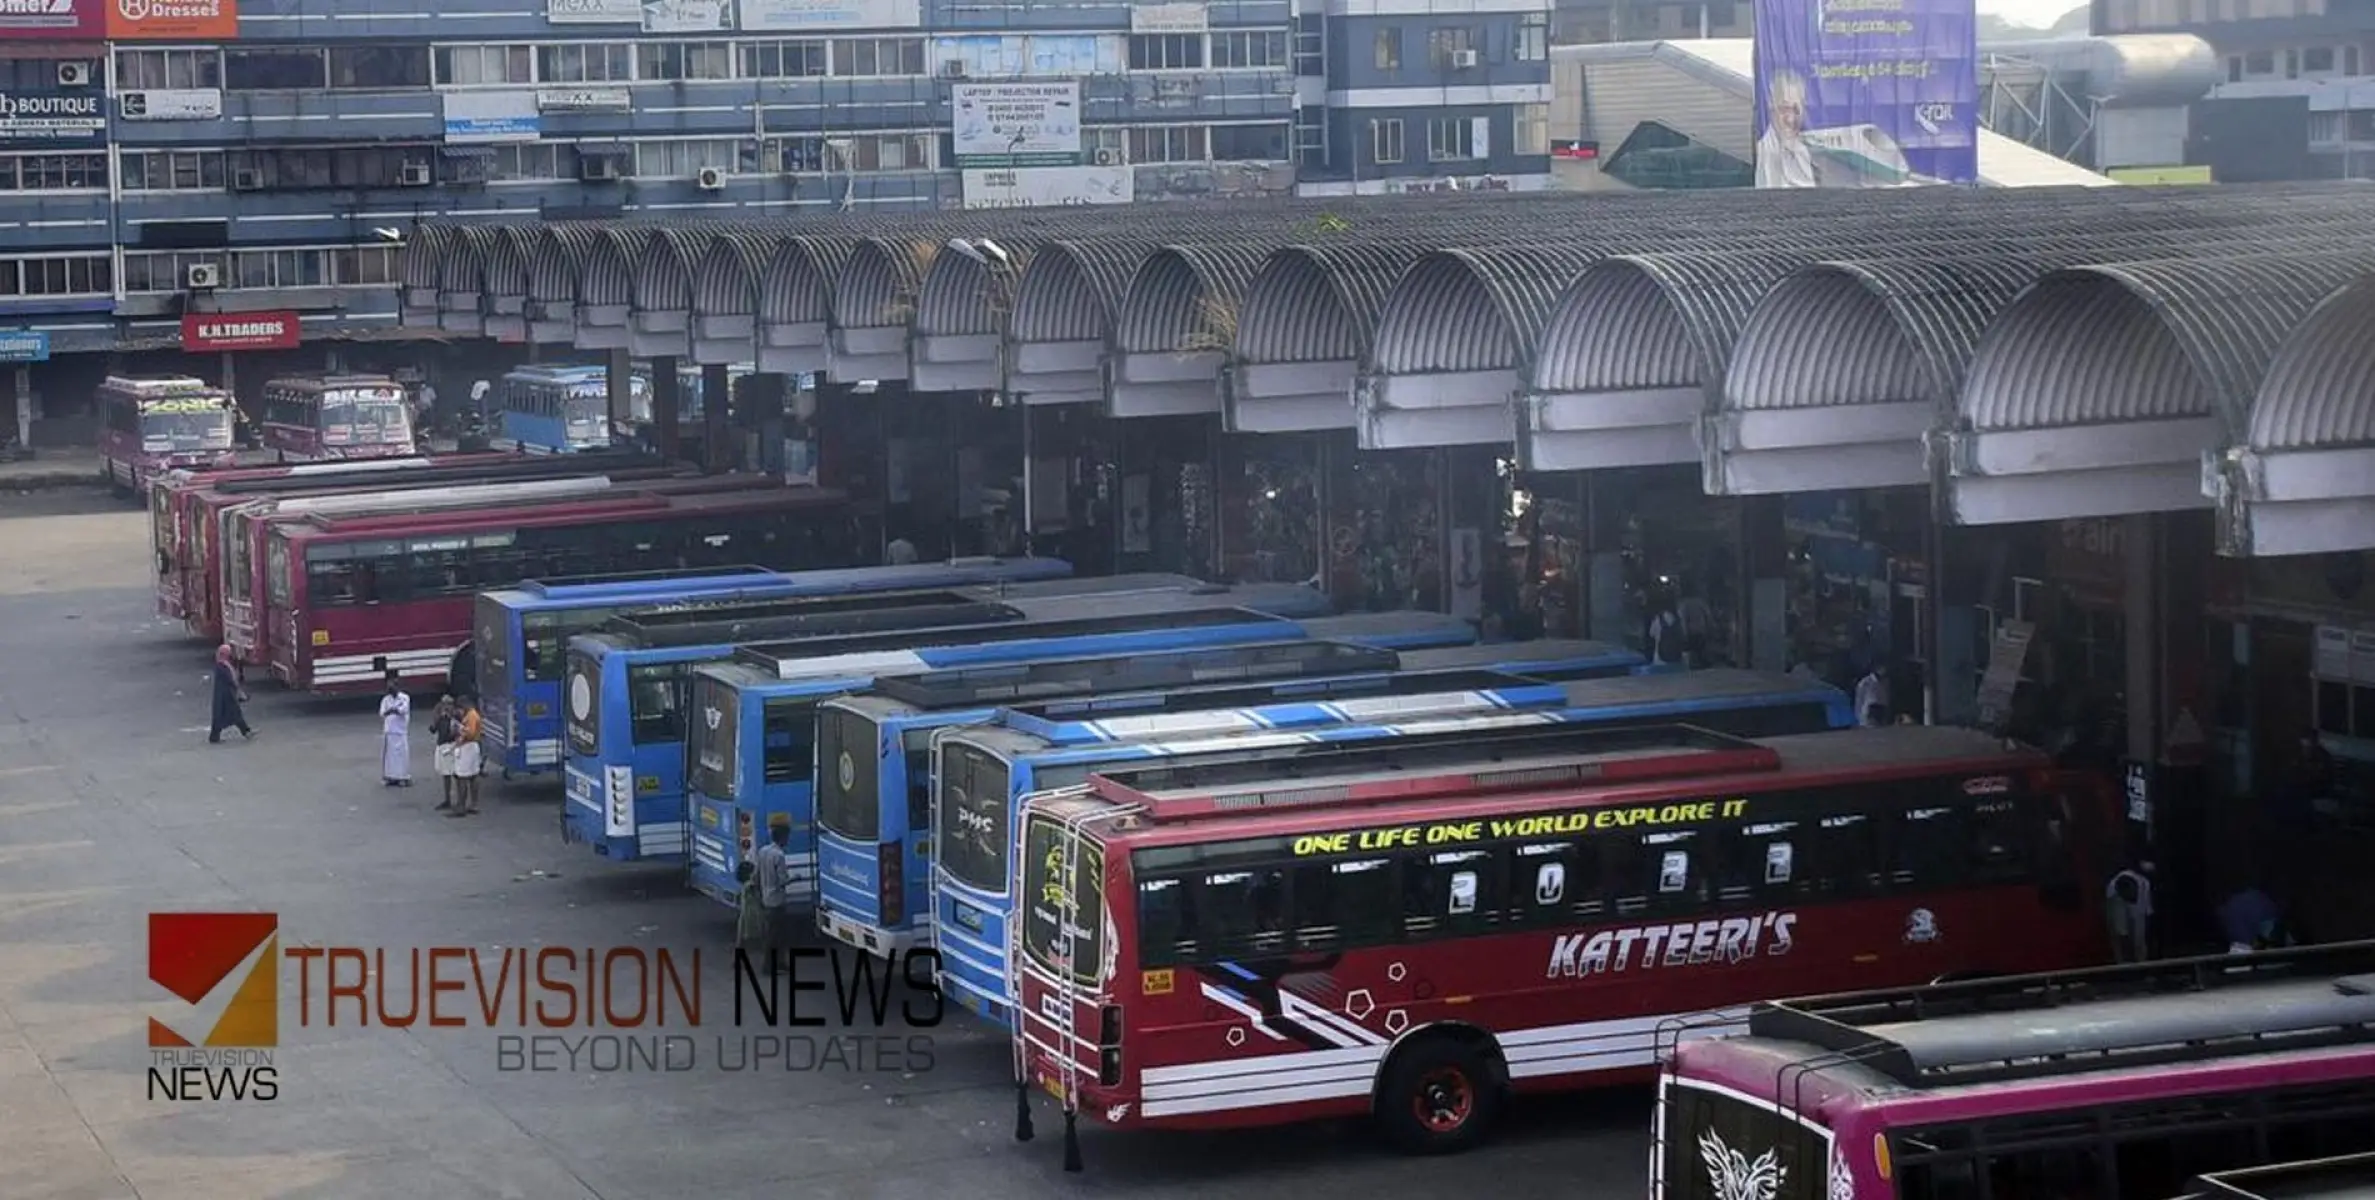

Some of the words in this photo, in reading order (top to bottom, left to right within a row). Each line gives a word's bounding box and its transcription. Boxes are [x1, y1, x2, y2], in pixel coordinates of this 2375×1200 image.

[152, 4, 219, 17] Dresses
[962, 88, 992, 97] LAPTOP
[1043, 87, 1069, 96] REPAIR
[19, 97, 97, 115] BOUTIQUE
[1293, 834, 1349, 855] ONE
[1358, 830, 1419, 850] LIFE
[1426, 825, 1482, 845] ONE
[1490, 813, 1588, 837] WORLD
[1595, 804, 1714, 829] EXPLORE
[1720, 799, 1748, 817] IT
